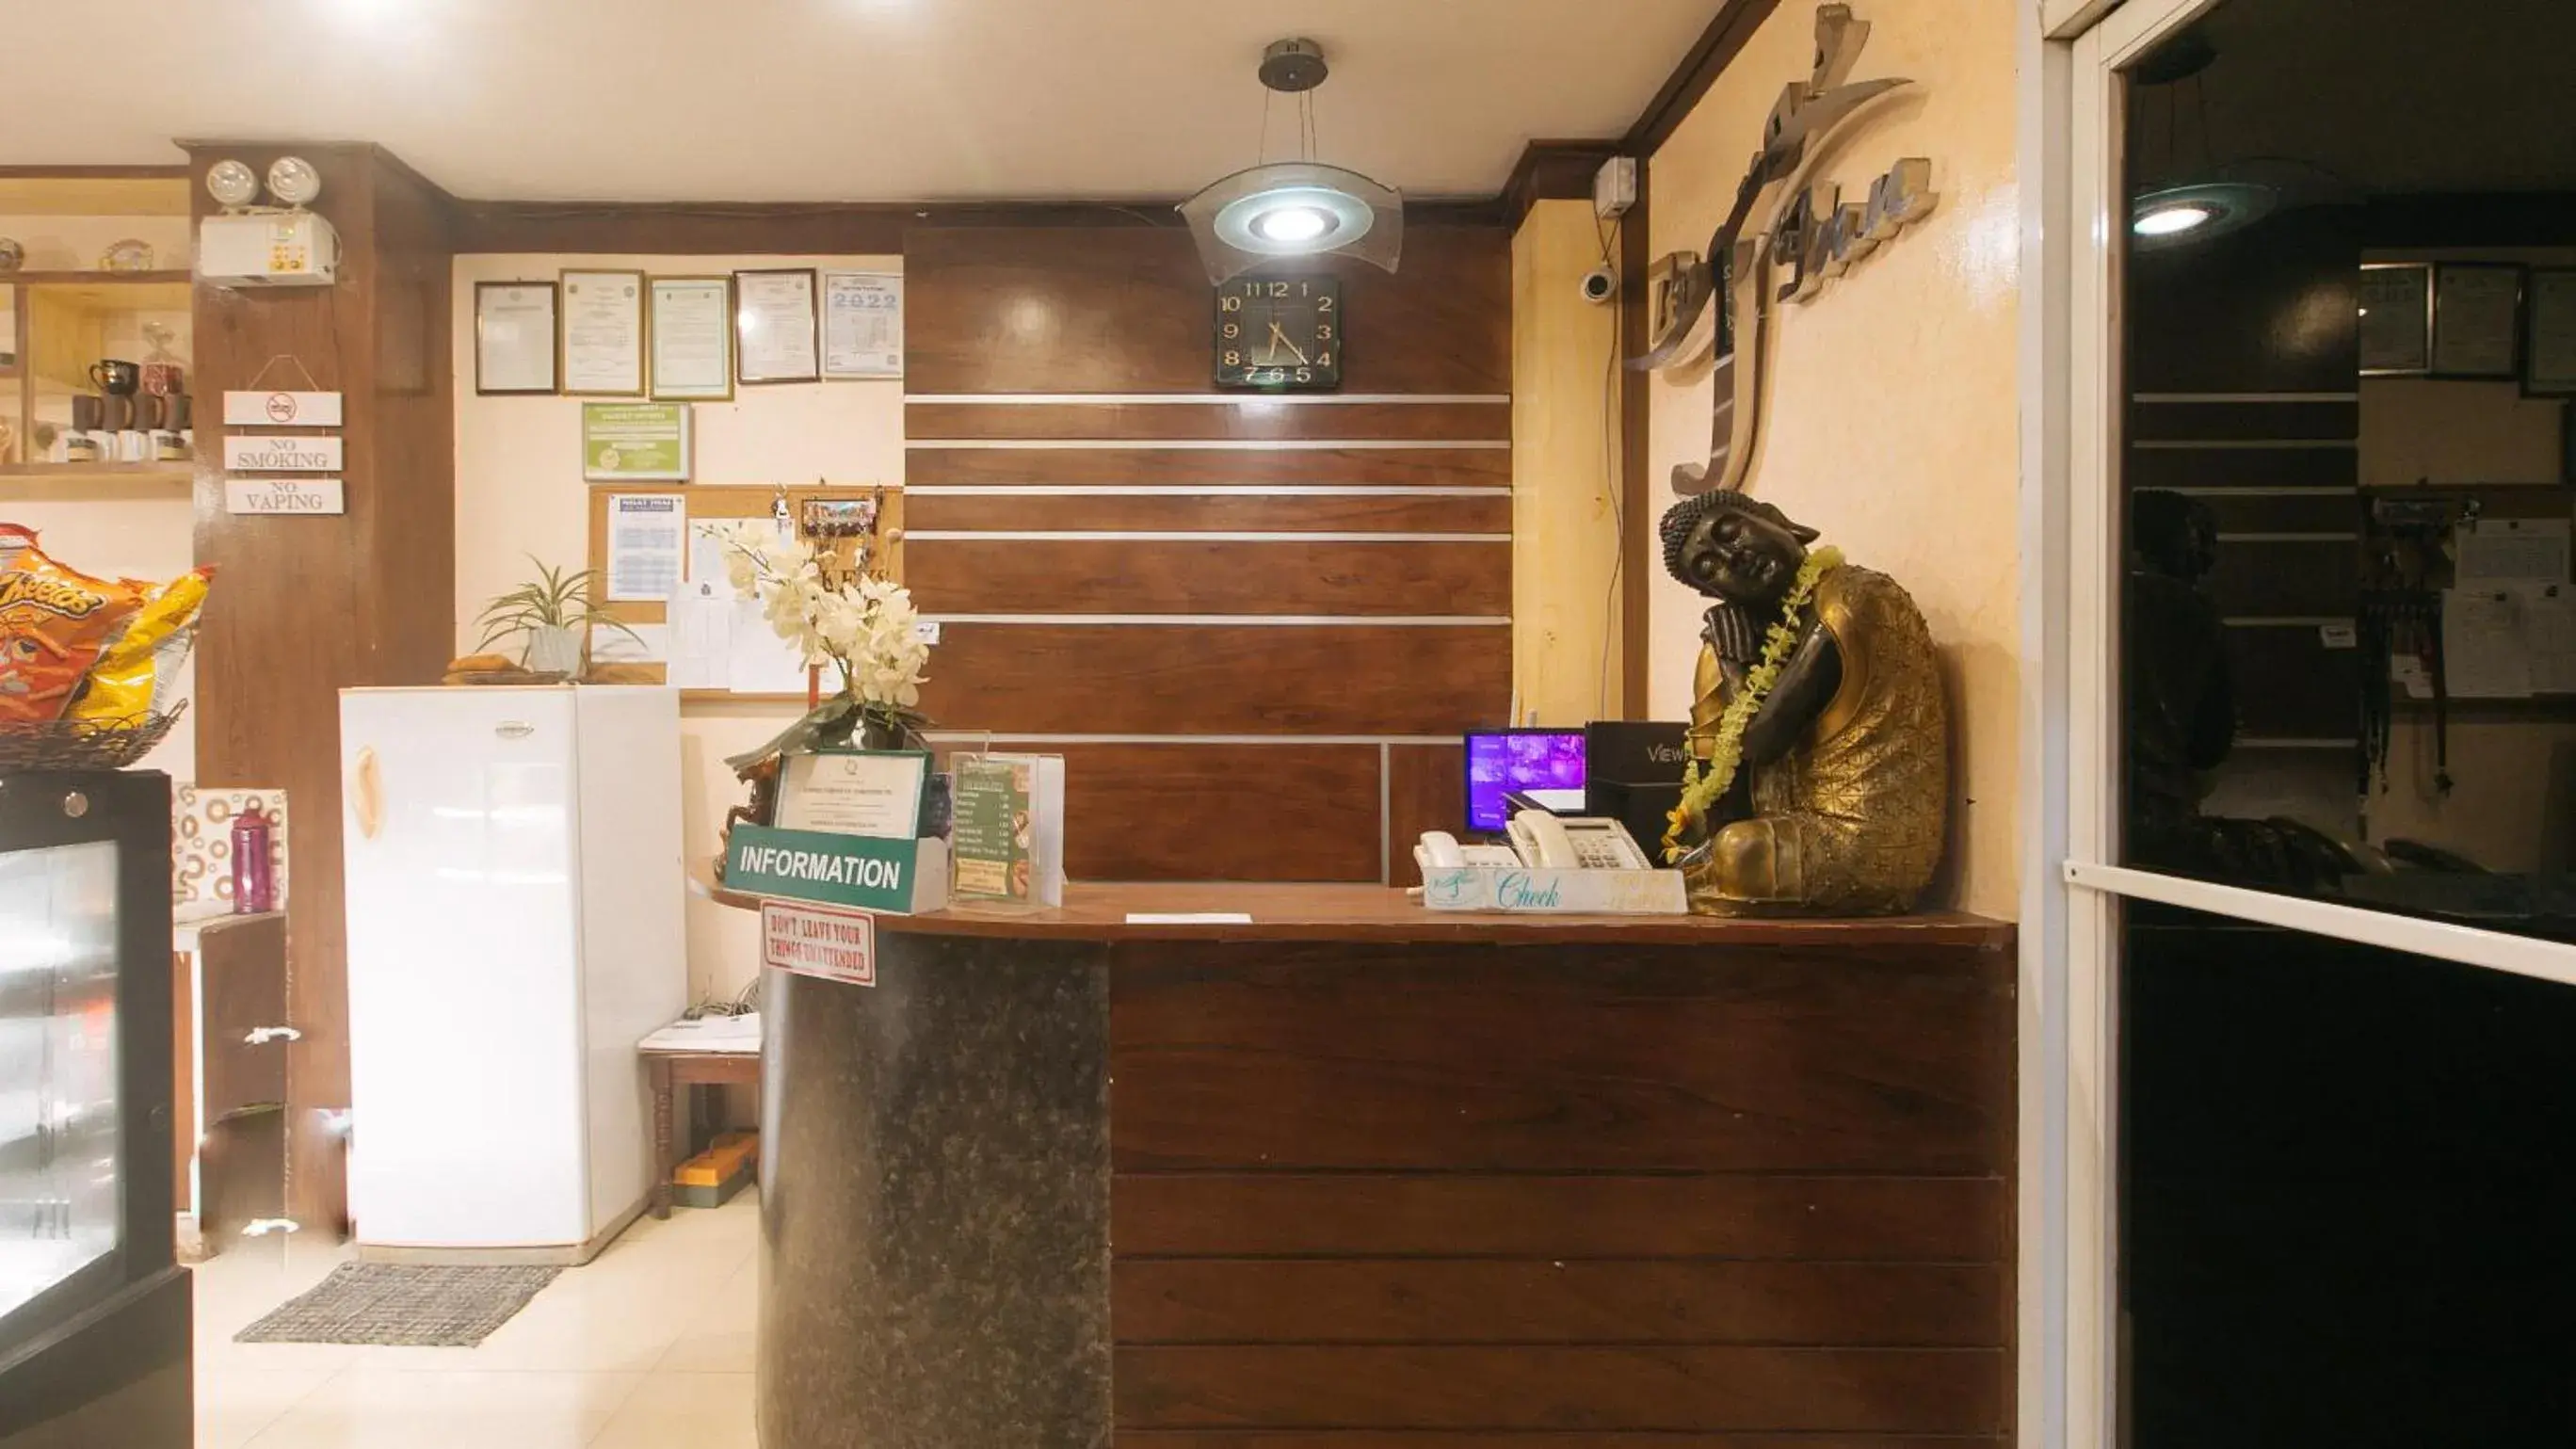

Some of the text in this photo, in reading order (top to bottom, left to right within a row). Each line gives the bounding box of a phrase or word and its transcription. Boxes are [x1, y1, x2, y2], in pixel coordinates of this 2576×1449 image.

[1246, 282, 1309, 298] 11 12 1
[833, 292, 896, 308] 2022
[1221, 297, 1241, 312] 10
[1318, 296, 1332, 312] 2
[1224, 323, 1239, 339] 9
[1316, 325, 1331, 340] 3
[1224, 349, 1240, 365] 8
[1316, 352, 1330, 367] 4
[1244, 366, 1311, 383] 7 6 5
[268, 439, 297, 452] NO
[237, 452, 329, 468] SMOKING
[269, 481, 298, 493] NO
[246, 493, 323, 510] VAPING
[740, 845, 901, 891] INFORMATION
[1497, 871, 1560, 909] Check
[801, 919, 832, 942] LEAVE
[833, 923, 861, 945] YOUR
